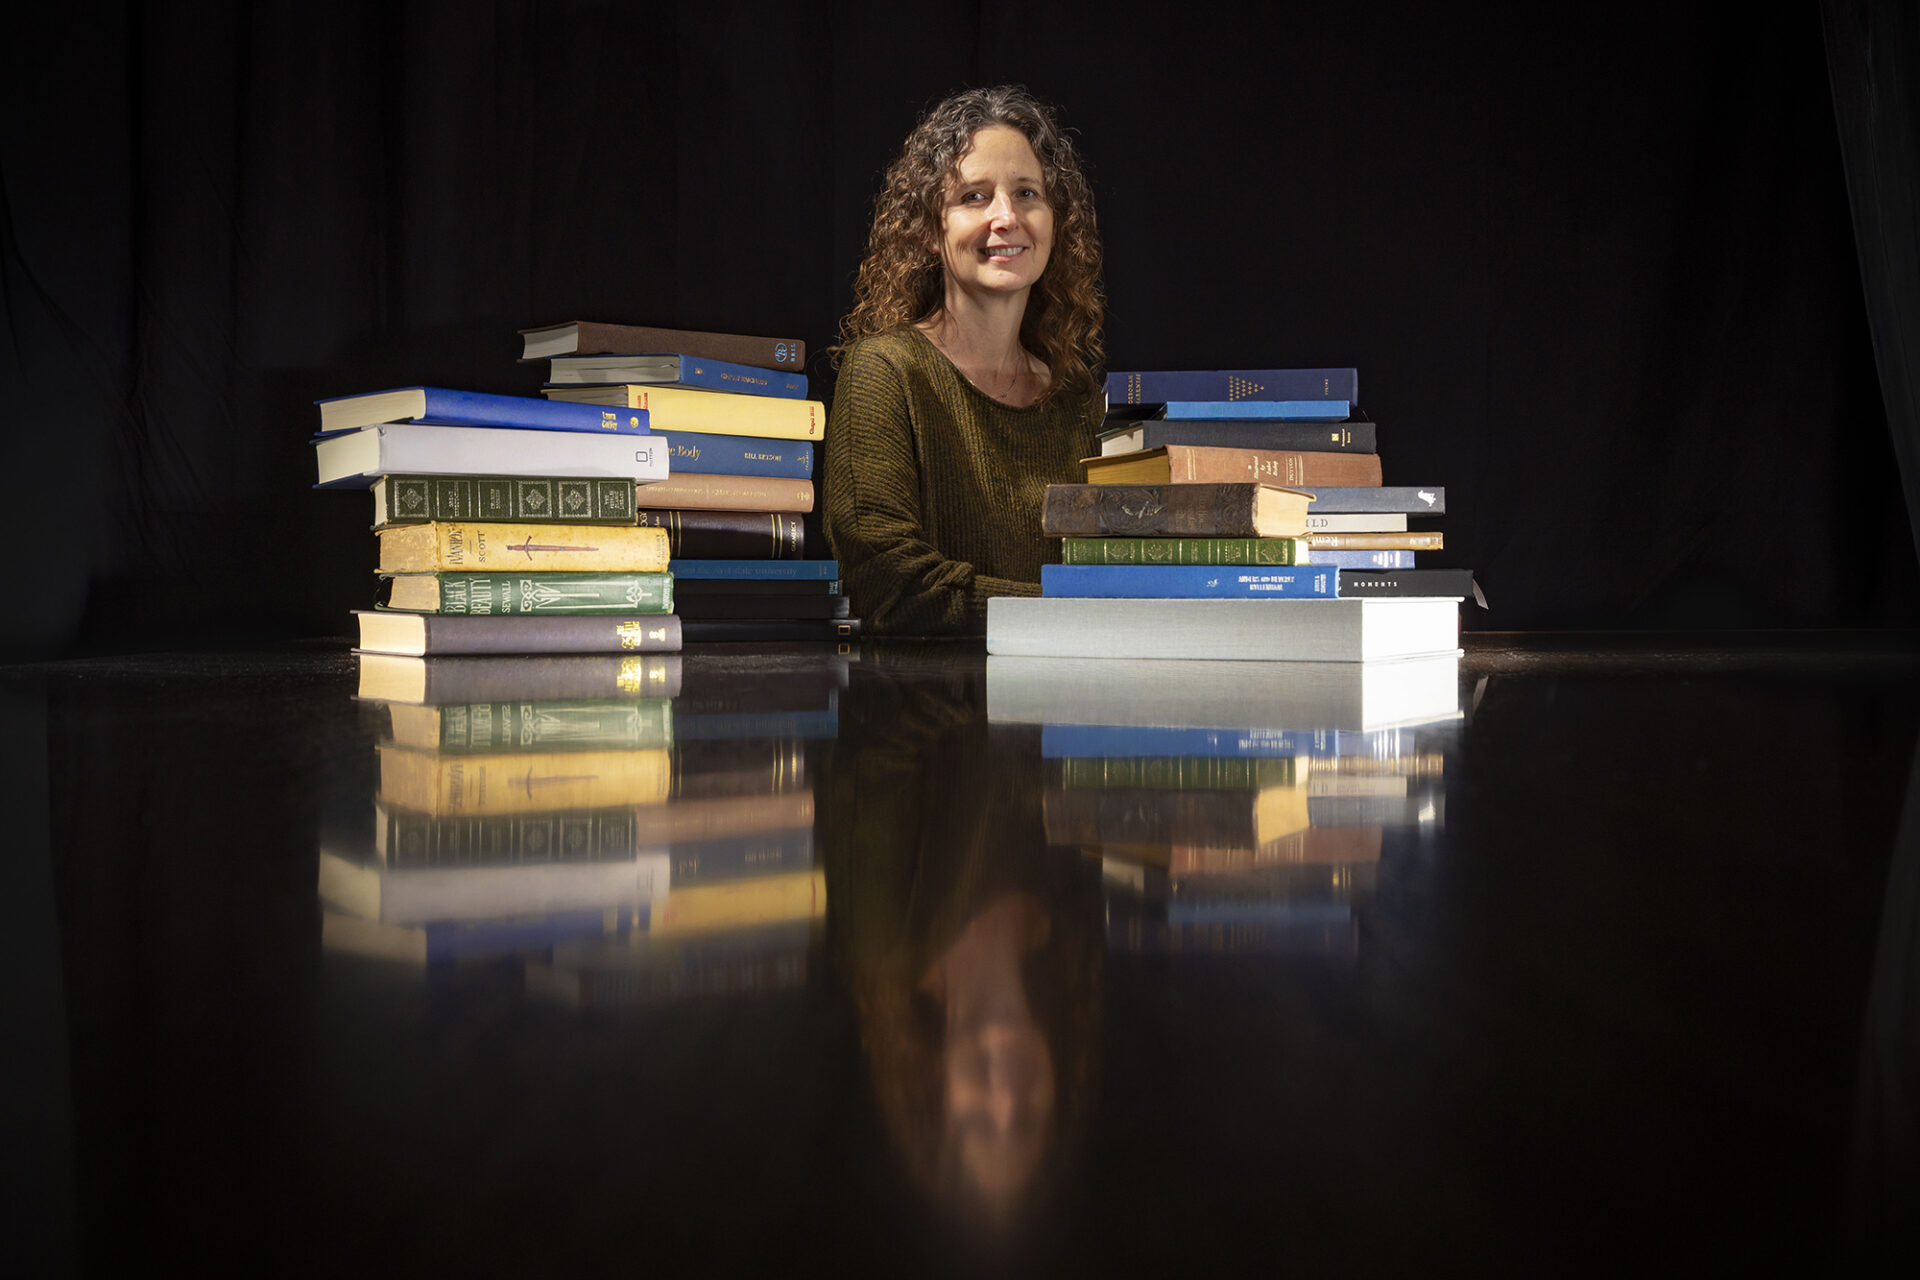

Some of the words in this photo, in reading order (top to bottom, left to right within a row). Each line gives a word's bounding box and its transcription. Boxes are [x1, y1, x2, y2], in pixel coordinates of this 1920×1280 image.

[808, 417, 816, 435] Chapel
[677, 445, 701, 461] Body
[447, 528, 463, 565] IVANHOE
[477, 530, 486, 563] SCOTT
[444, 580, 466, 614] BLACK
[469, 577, 492, 615] BEAUTY
[501, 580, 511, 613] SEWALL
